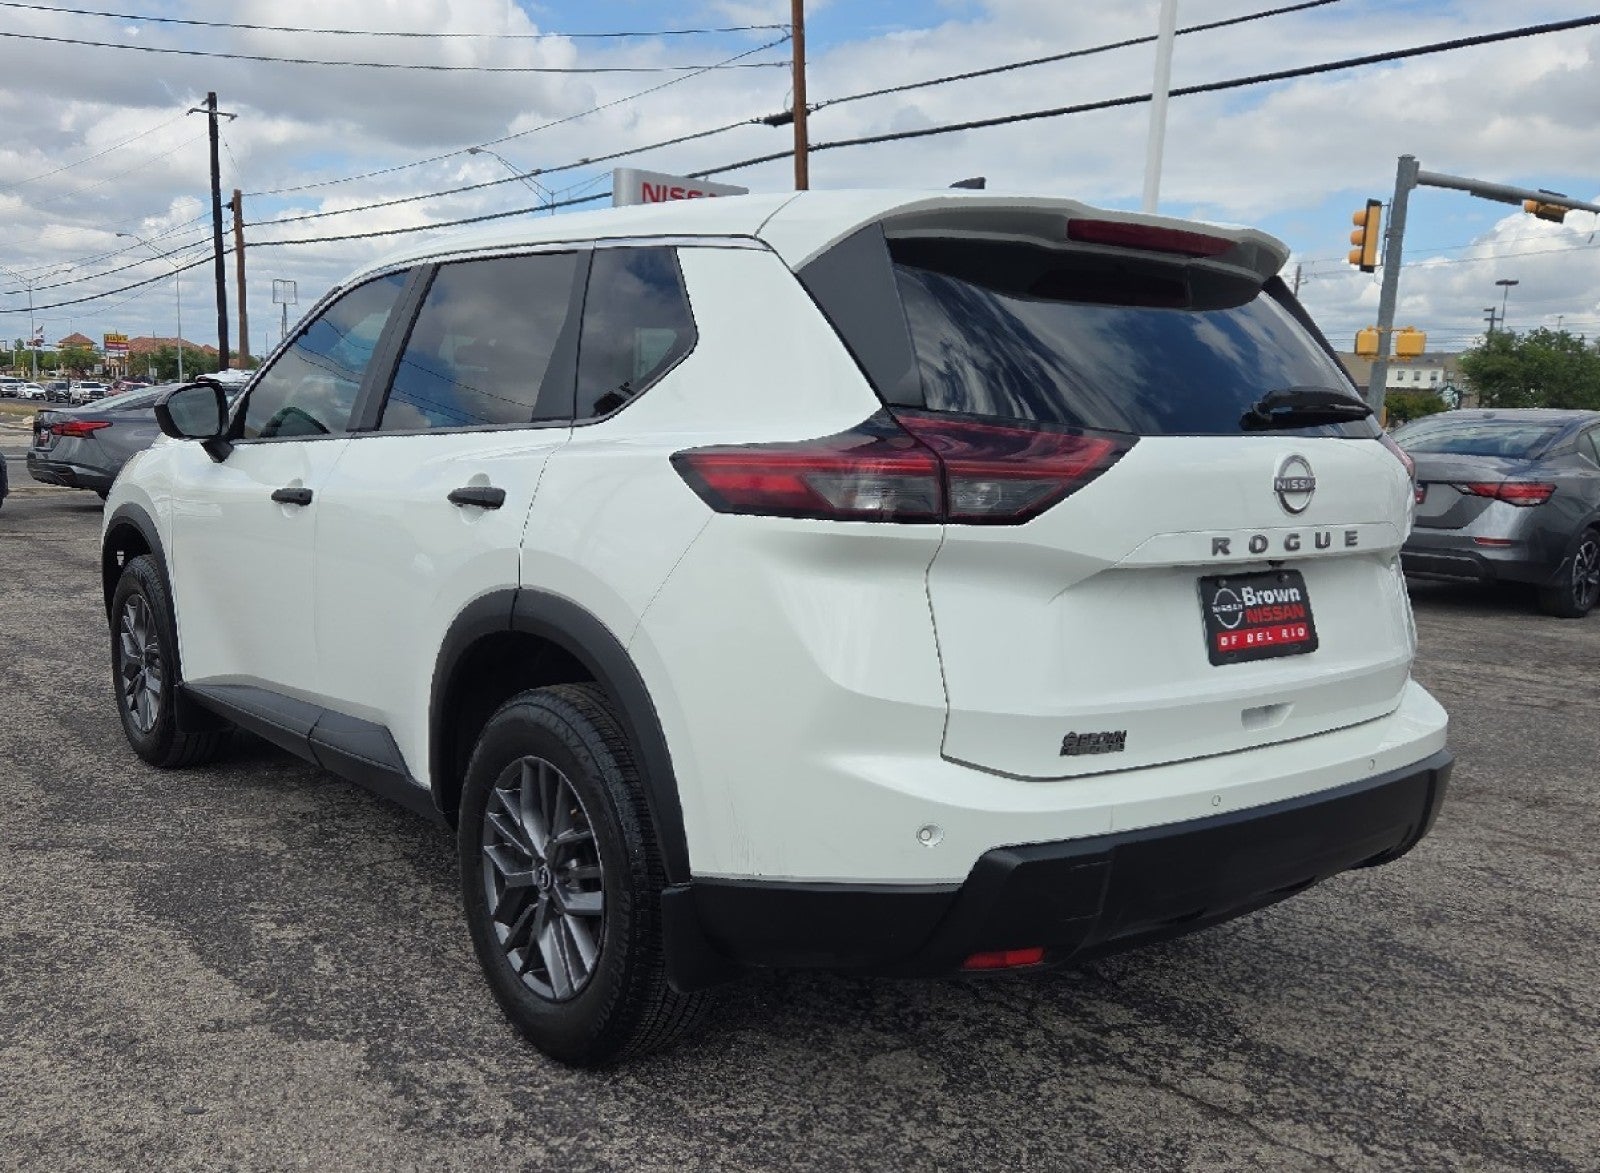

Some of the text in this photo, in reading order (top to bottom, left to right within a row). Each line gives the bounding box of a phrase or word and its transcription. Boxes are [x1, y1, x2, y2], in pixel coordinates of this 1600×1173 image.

[642, 182, 717, 203] NISS
[1211, 530, 1358, 556] ROGUE
[1241, 586, 1301, 606] Brown
[1246, 603, 1305, 623] NISSAN
[1220, 627, 1306, 646] OF DEL RIO
